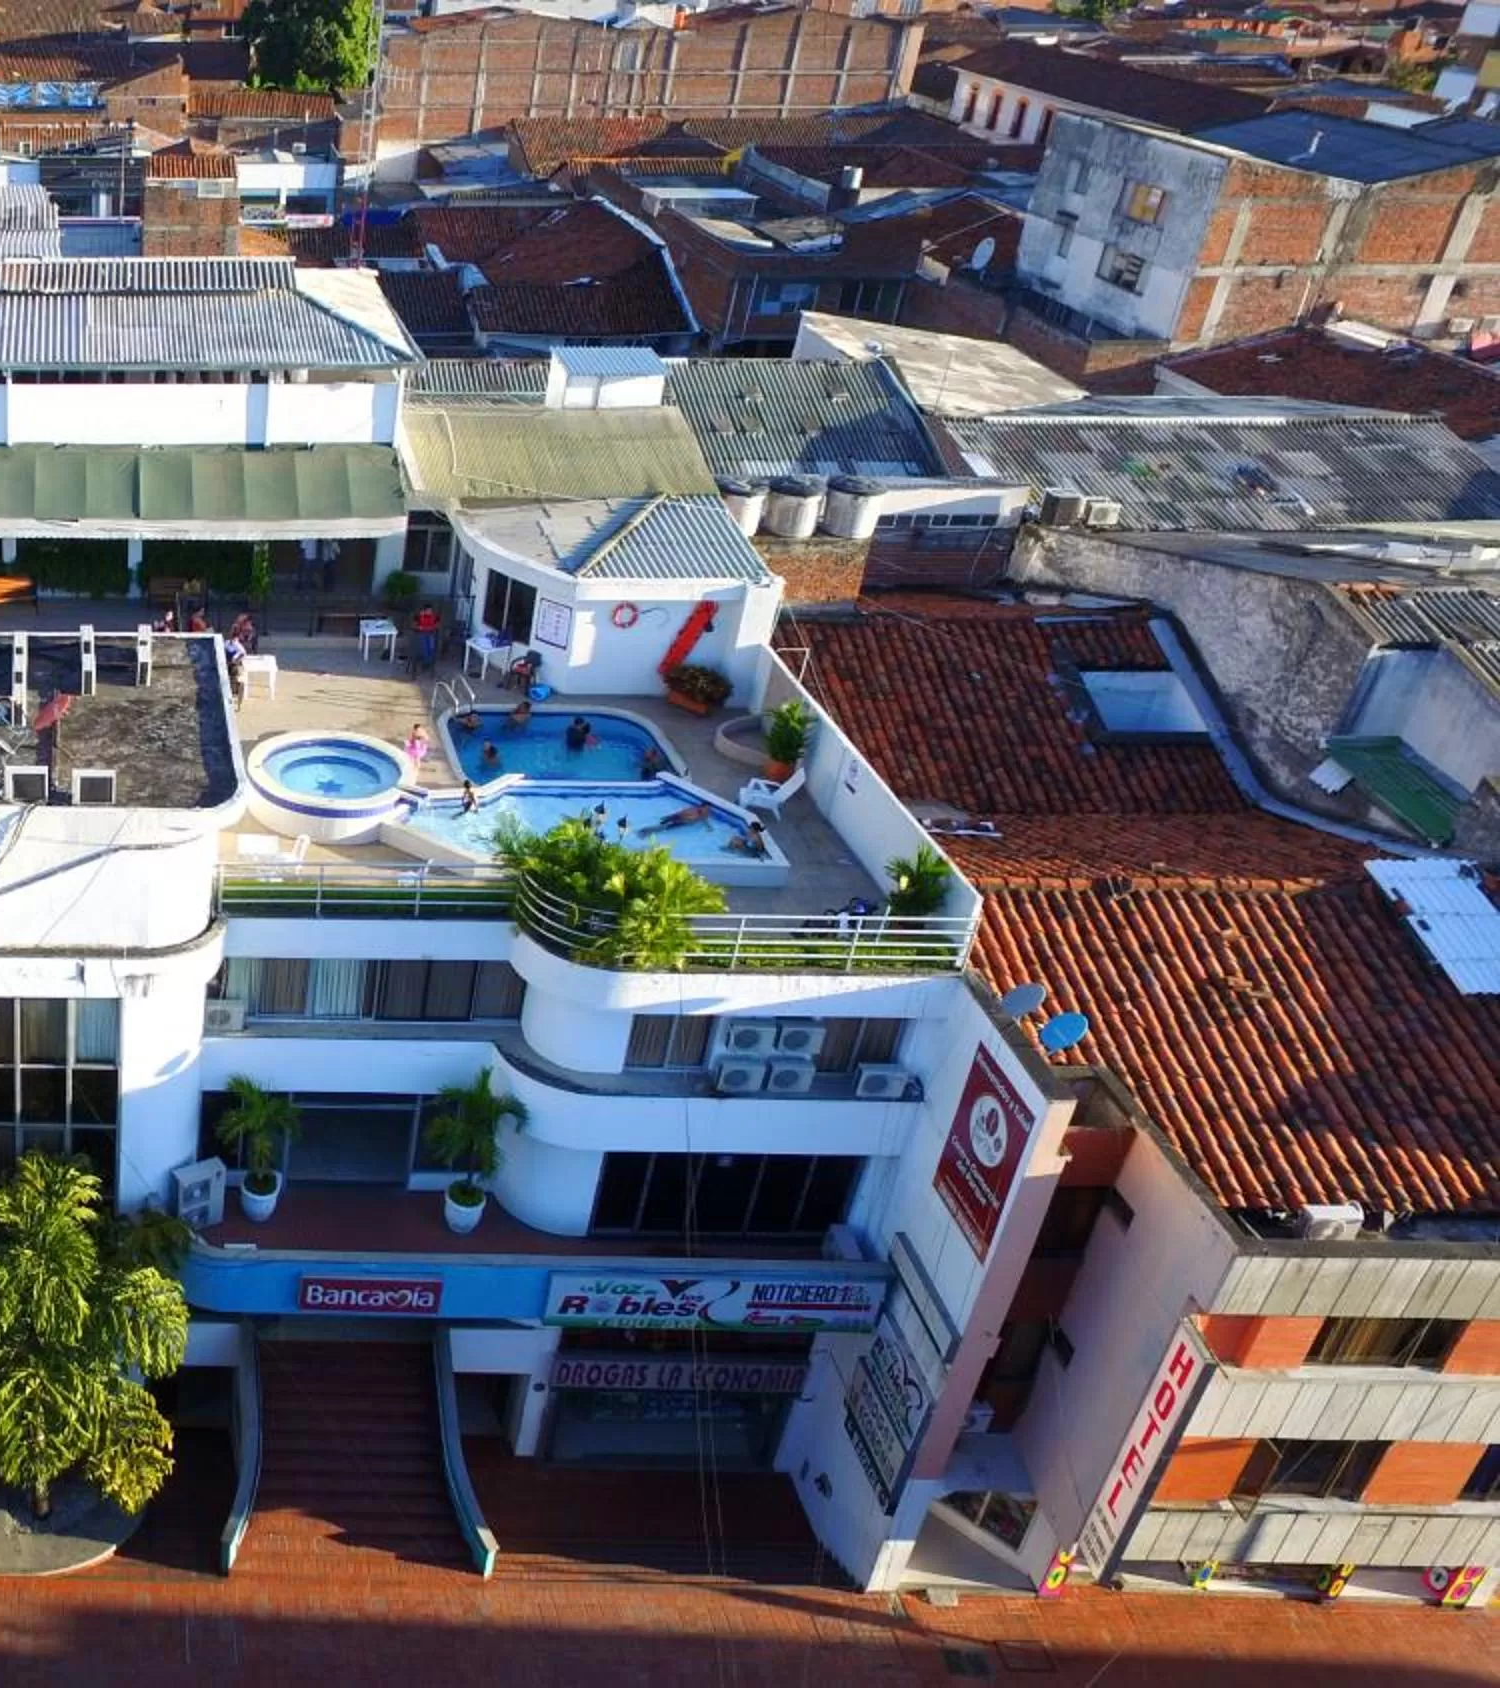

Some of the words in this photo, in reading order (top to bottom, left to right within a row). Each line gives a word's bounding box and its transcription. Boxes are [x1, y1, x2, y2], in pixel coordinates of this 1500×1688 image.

[595, 1280, 645, 1295] Voz
[753, 1283, 838, 1303] NOTICIERO
[557, 1363, 648, 1387] DROGAS
[657, 1366, 681, 1389] LA
[1107, 1342, 1195, 1519] HOTEL
